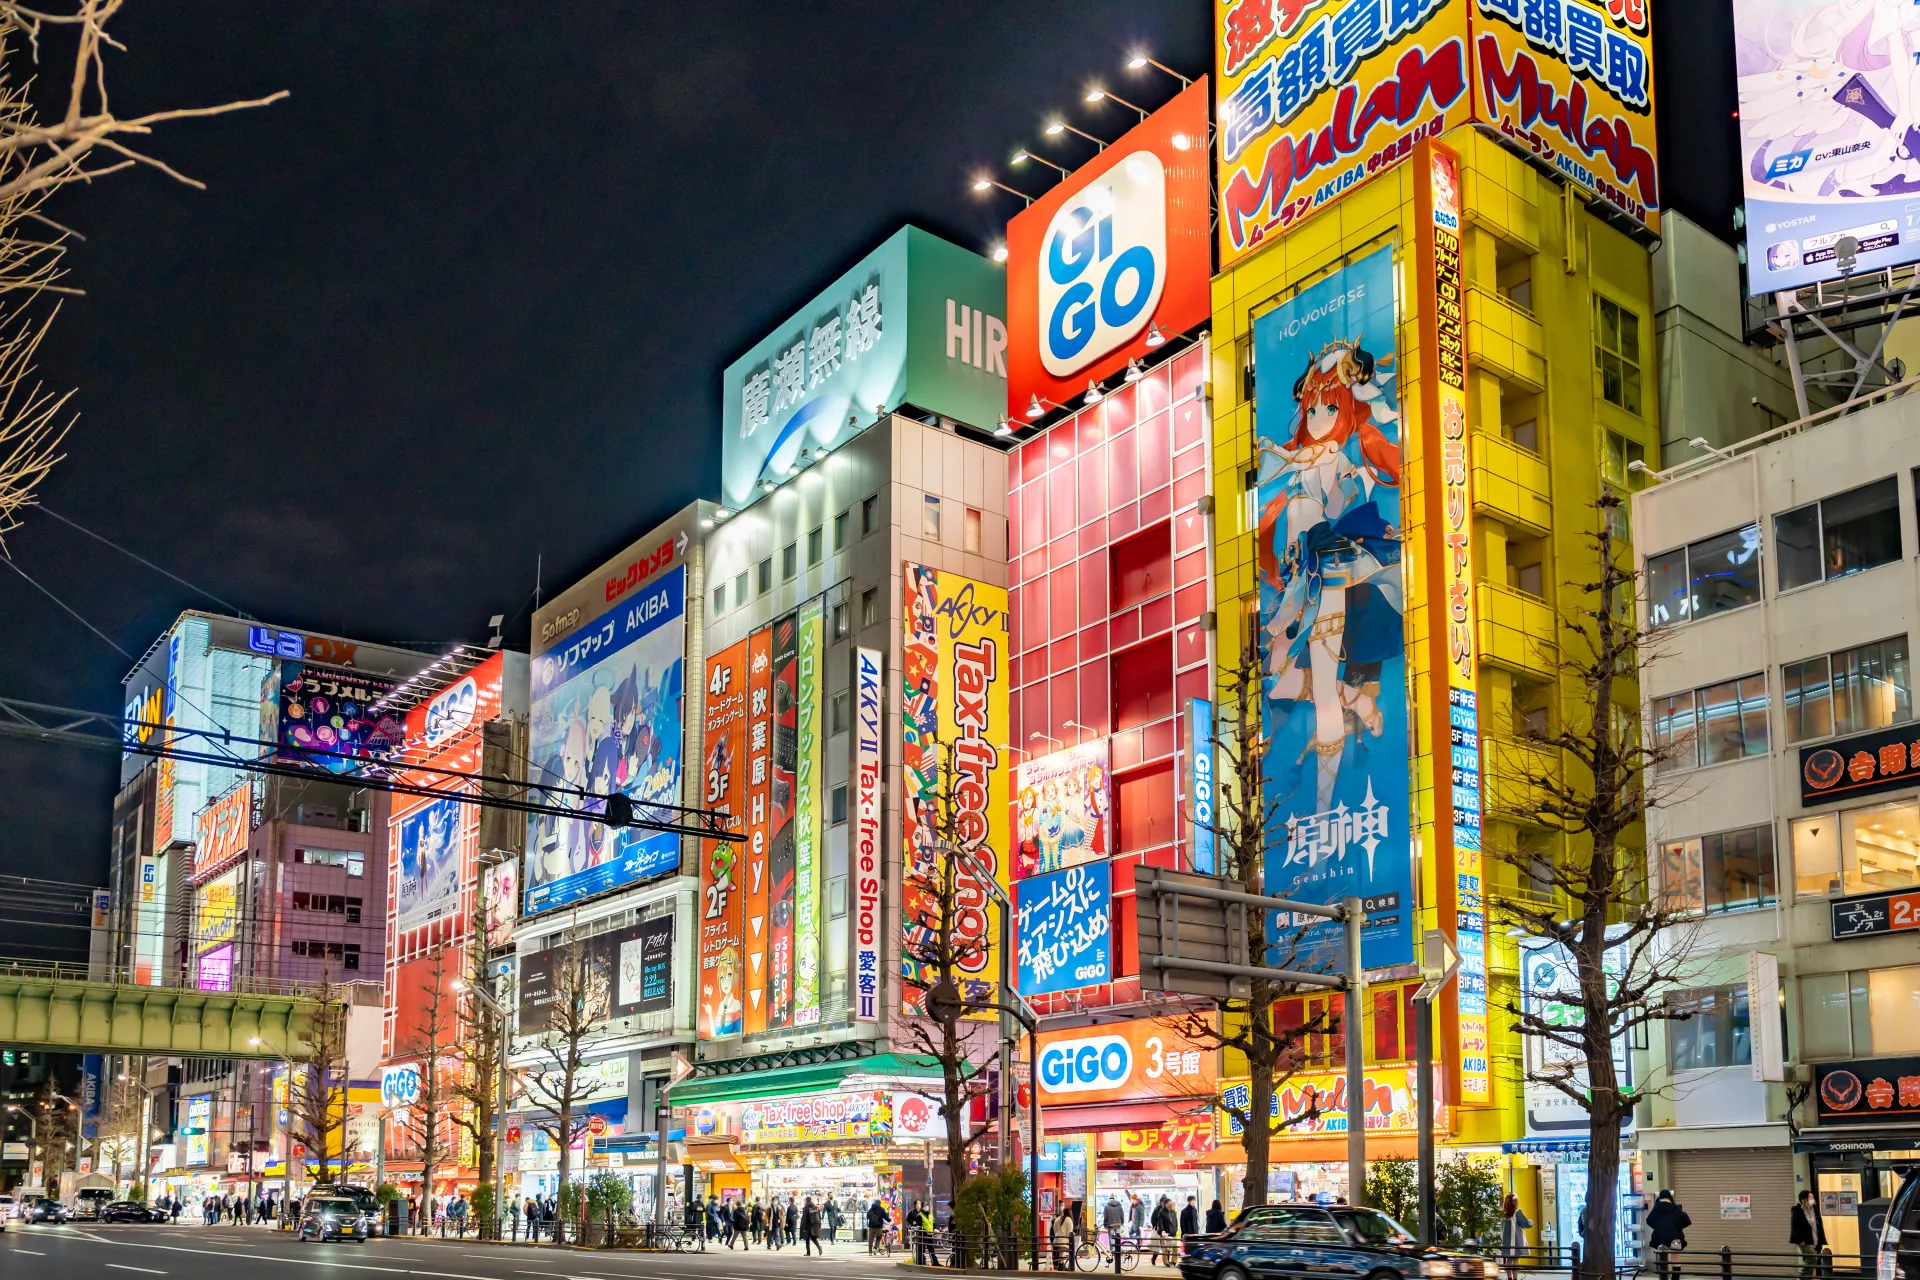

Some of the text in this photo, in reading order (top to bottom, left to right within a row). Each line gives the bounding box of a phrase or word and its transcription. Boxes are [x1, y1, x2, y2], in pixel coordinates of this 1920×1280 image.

[1478, 35, 1658, 209] Mulan
[1224, 39, 1466, 248] Mulan
[1500, 115, 1647, 224] ムーラン AKIBA 中央通り店
[1775, 156, 1803, 173] ミカ
[1248, 114, 1445, 248] ムーラン AKIBA 中央通り店
[1434, 209, 1458, 229] あなたの
[1777, 214, 1817, 229] YOSTAR
[1436, 228, 1458, 251] DVD
[1435, 246, 1459, 270] ブルーレイ
[1436, 263, 1460, 287] ゲーム
[1441, 282, 1456, 300] CD
[1048, 245, 1155, 360] GO
[1438, 297, 1460, 319] アイドル
[1438, 314, 1461, 336] アニメ
[1439, 333, 1461, 354] コミック
[1441, 350, 1462, 369] ホビー
[1440, 367, 1463, 391] フィギュア
[606, 537, 674, 602] ビックカメラ
[936, 590, 999, 634] AKKY
[542, 608, 580, 643] Sofmap
[557, 589, 669, 673] ソフマップ AKIBA
[316, 671, 371, 686] AMUSEMENT
[708, 663, 731, 697] 4F
[708, 691, 744, 718] カードゲーム
[860, 653, 878, 734] AKKY
[1449, 689, 1476, 709] 6F 中古
[707, 707, 745, 732] オンラインゲーム
[1453, 714, 1475, 729] DVD
[955, 640, 994, 844] Tax-free
[1451, 729, 1477, 748] 5F 中古
[1454, 753, 1477, 769] DVD
[707, 768, 729, 803] 3F
[1195, 752, 1210, 823] GiGO
[1452, 769, 1479, 788] 4F 中古
[1455, 793, 1478, 810] DVD
[860, 760, 878, 873] Tax-free
[1453, 809, 1480, 828] 3F 中古
[1282, 778, 1390, 882] 原神
[1293, 866, 1354, 885] Genshin
[1458, 873, 1480, 892] 買取
[705, 884, 728, 921] 2F
[1018, 866, 1085, 932] ゲームの
[1458, 891, 1481, 908] フロア
[1854, 903, 1864, 911] 3F
[858, 877, 878, 945] Shop
[1018, 877, 1101, 966] オアシスに
[1873, 910, 1884, 918] 2F
[1457, 913, 1483, 932] 1F 中古
[703, 936, 740, 954] レトロゲーム
[1458, 935, 1484, 952] TVゲーム
[703, 951, 734, 970] 音楽ゲーム
[1075, 963, 1106, 980] GiGO
[644, 985, 666, 997] RELEASE
[1459, 974, 1486, 992] B1F 中古
[1462, 1021, 1485, 1034] Mulan
[1462, 1037, 1486, 1052] ムーラン
[1041, 1036, 1201, 1086] GiGO 3号館
[1463, 1056, 1487, 1073] AKIBA
[86, 1072, 97, 1108] AKIBA
[1223, 1084, 1249, 1108] 買取
[1463, 1077, 1488, 1093] 中央通り店
[1281, 1076, 1395, 1122] Muln
[762, 1098, 846, 1125] Tax-free Shop
[1326, 1117, 1348, 1131] AKIB
[1039, 1152, 1059, 1161] GiGO
